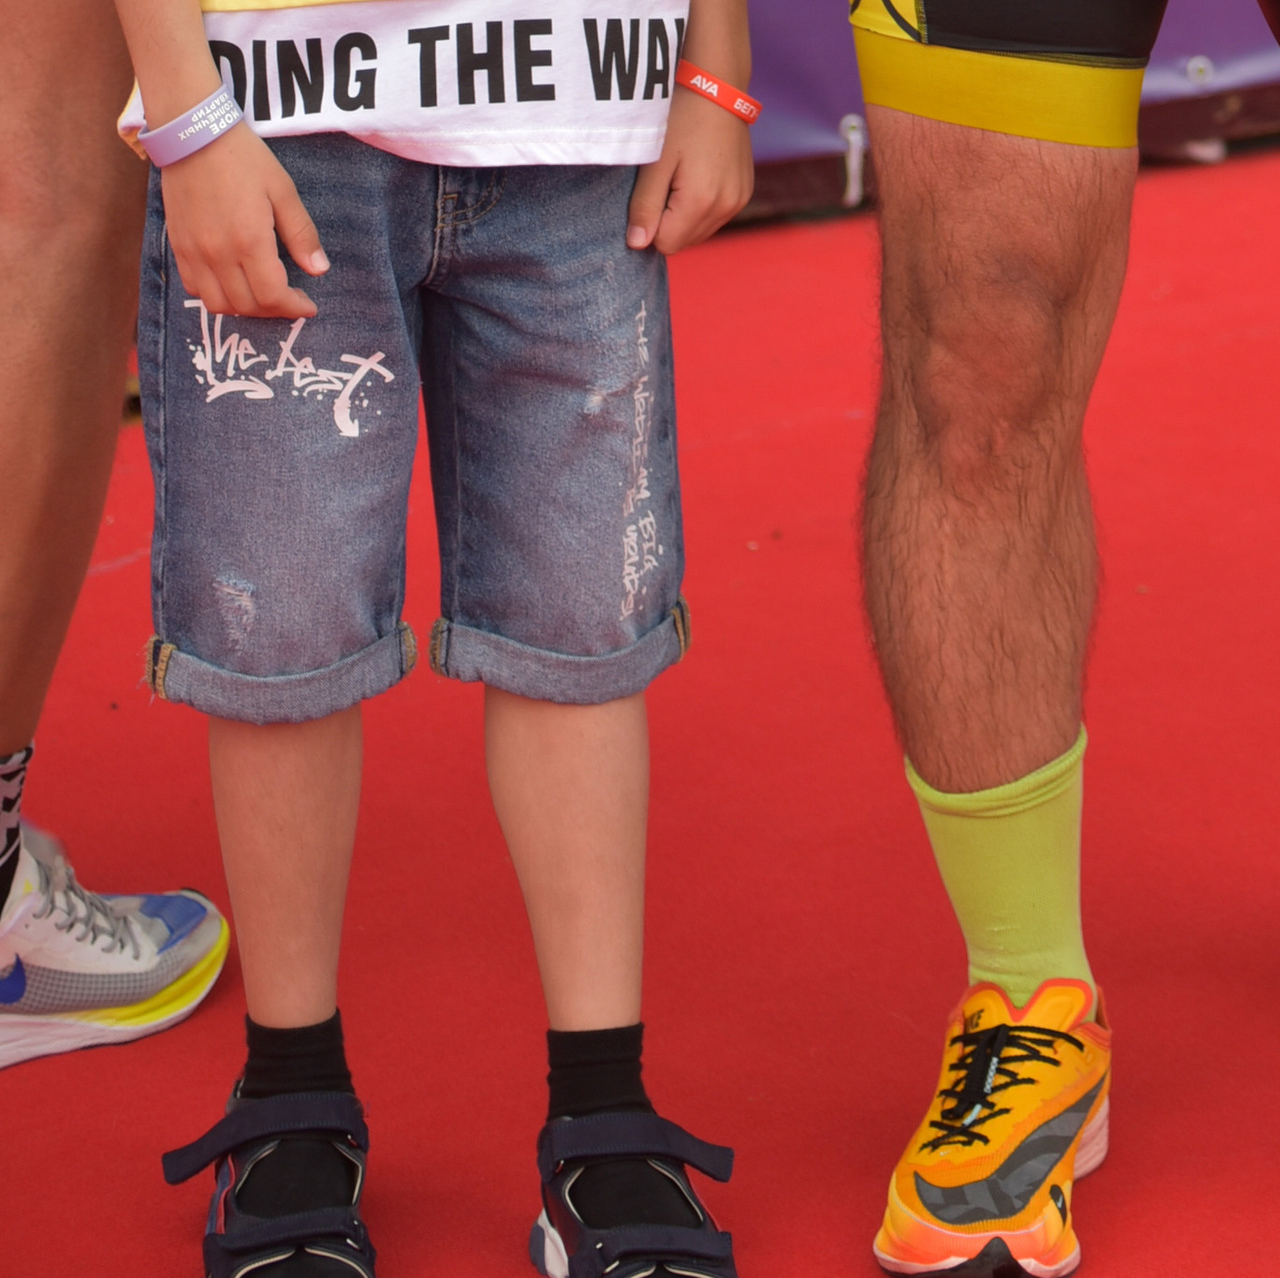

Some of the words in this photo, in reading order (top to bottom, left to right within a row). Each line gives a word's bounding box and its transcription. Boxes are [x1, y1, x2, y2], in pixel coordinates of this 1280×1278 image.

[408, 18, 556, 108] THE
[583, 18, 686, 101] WA
[690, 74, 719, 98] AVA
[177, 100, 234, 141] СОЛНЕЧНЫХ
[209, 108, 240, 136] МОРЕ
